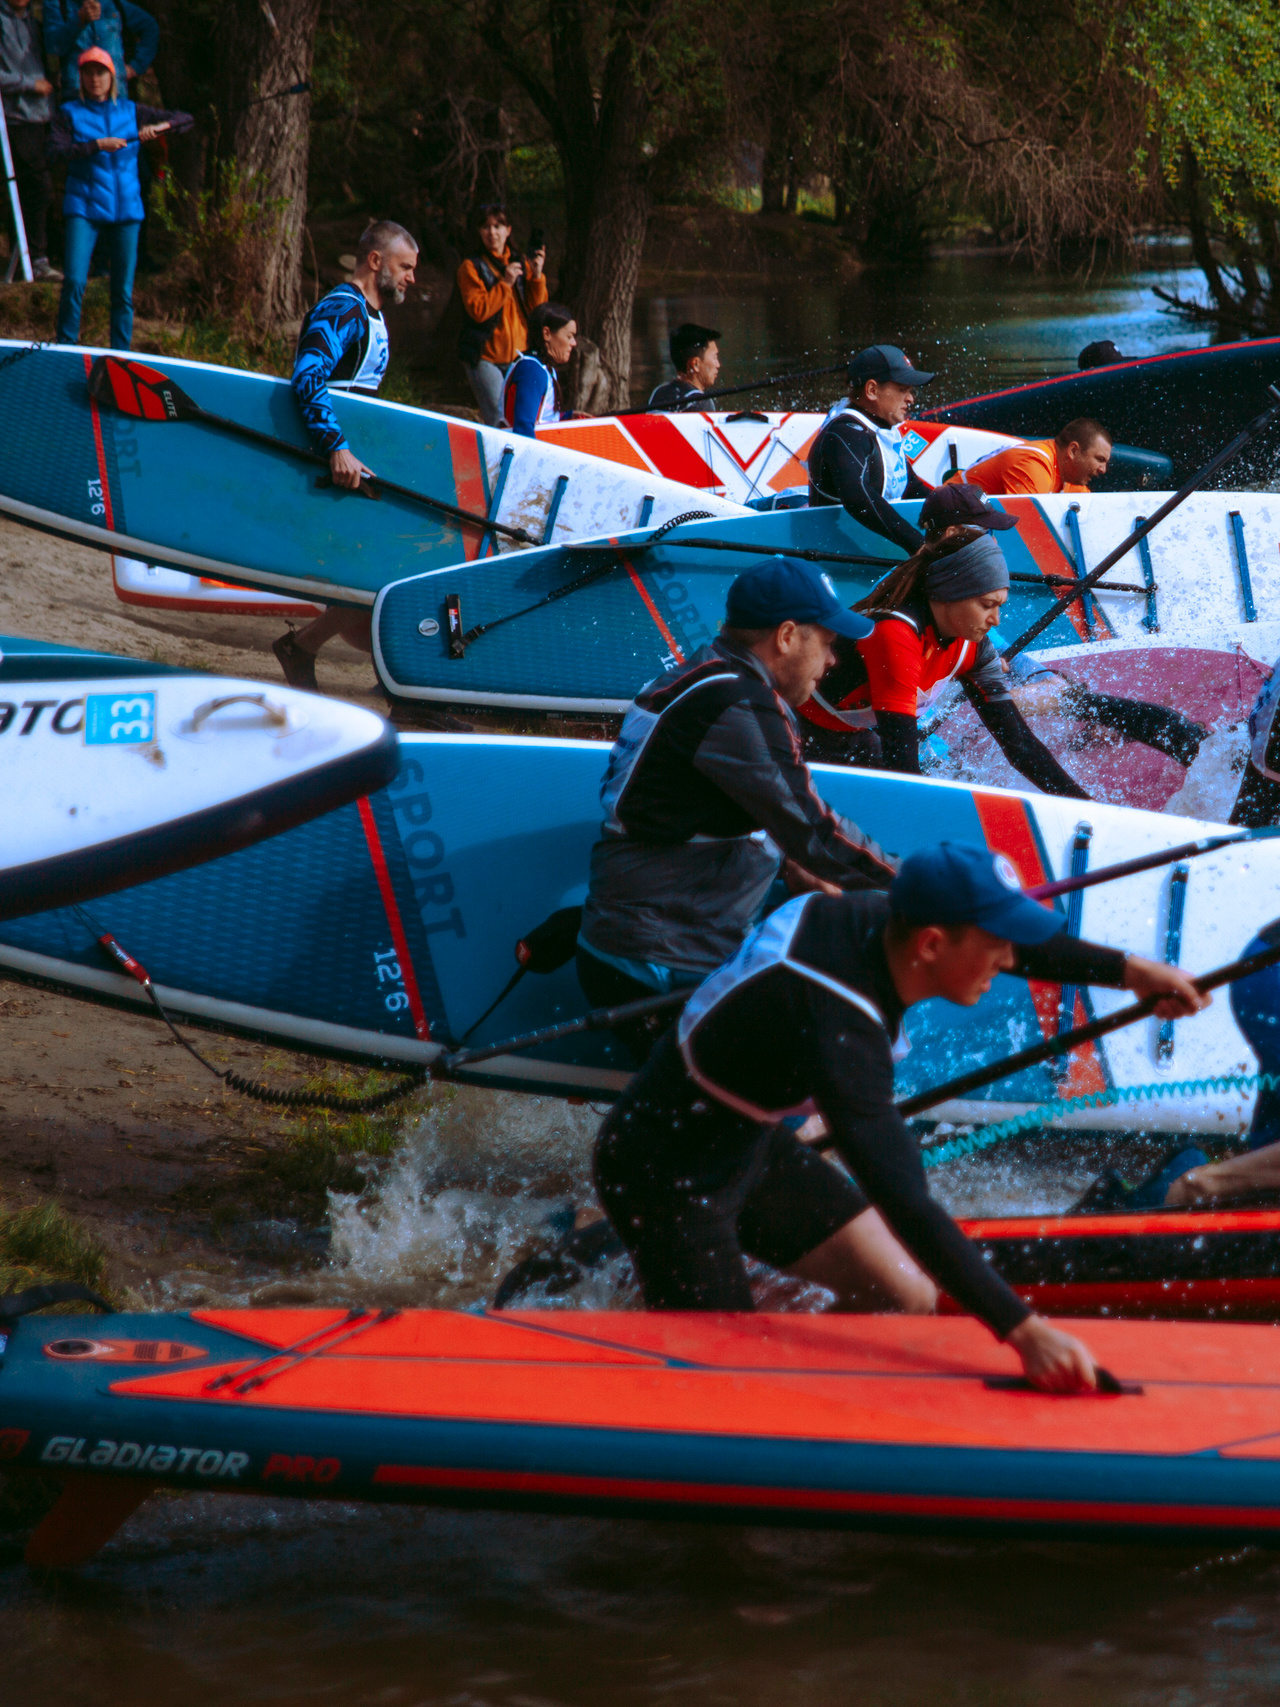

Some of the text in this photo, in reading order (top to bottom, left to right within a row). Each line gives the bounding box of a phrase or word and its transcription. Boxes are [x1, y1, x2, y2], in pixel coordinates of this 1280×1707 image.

[163, 390, 178, 418] ELITE
[114, 418, 142, 478] ORT
[110, 698, 149, 739] 33
[389, 758, 467, 939] SPORT
[374, 948, 410, 1012] 12'6
[263, 1453, 341, 1483] PRO
